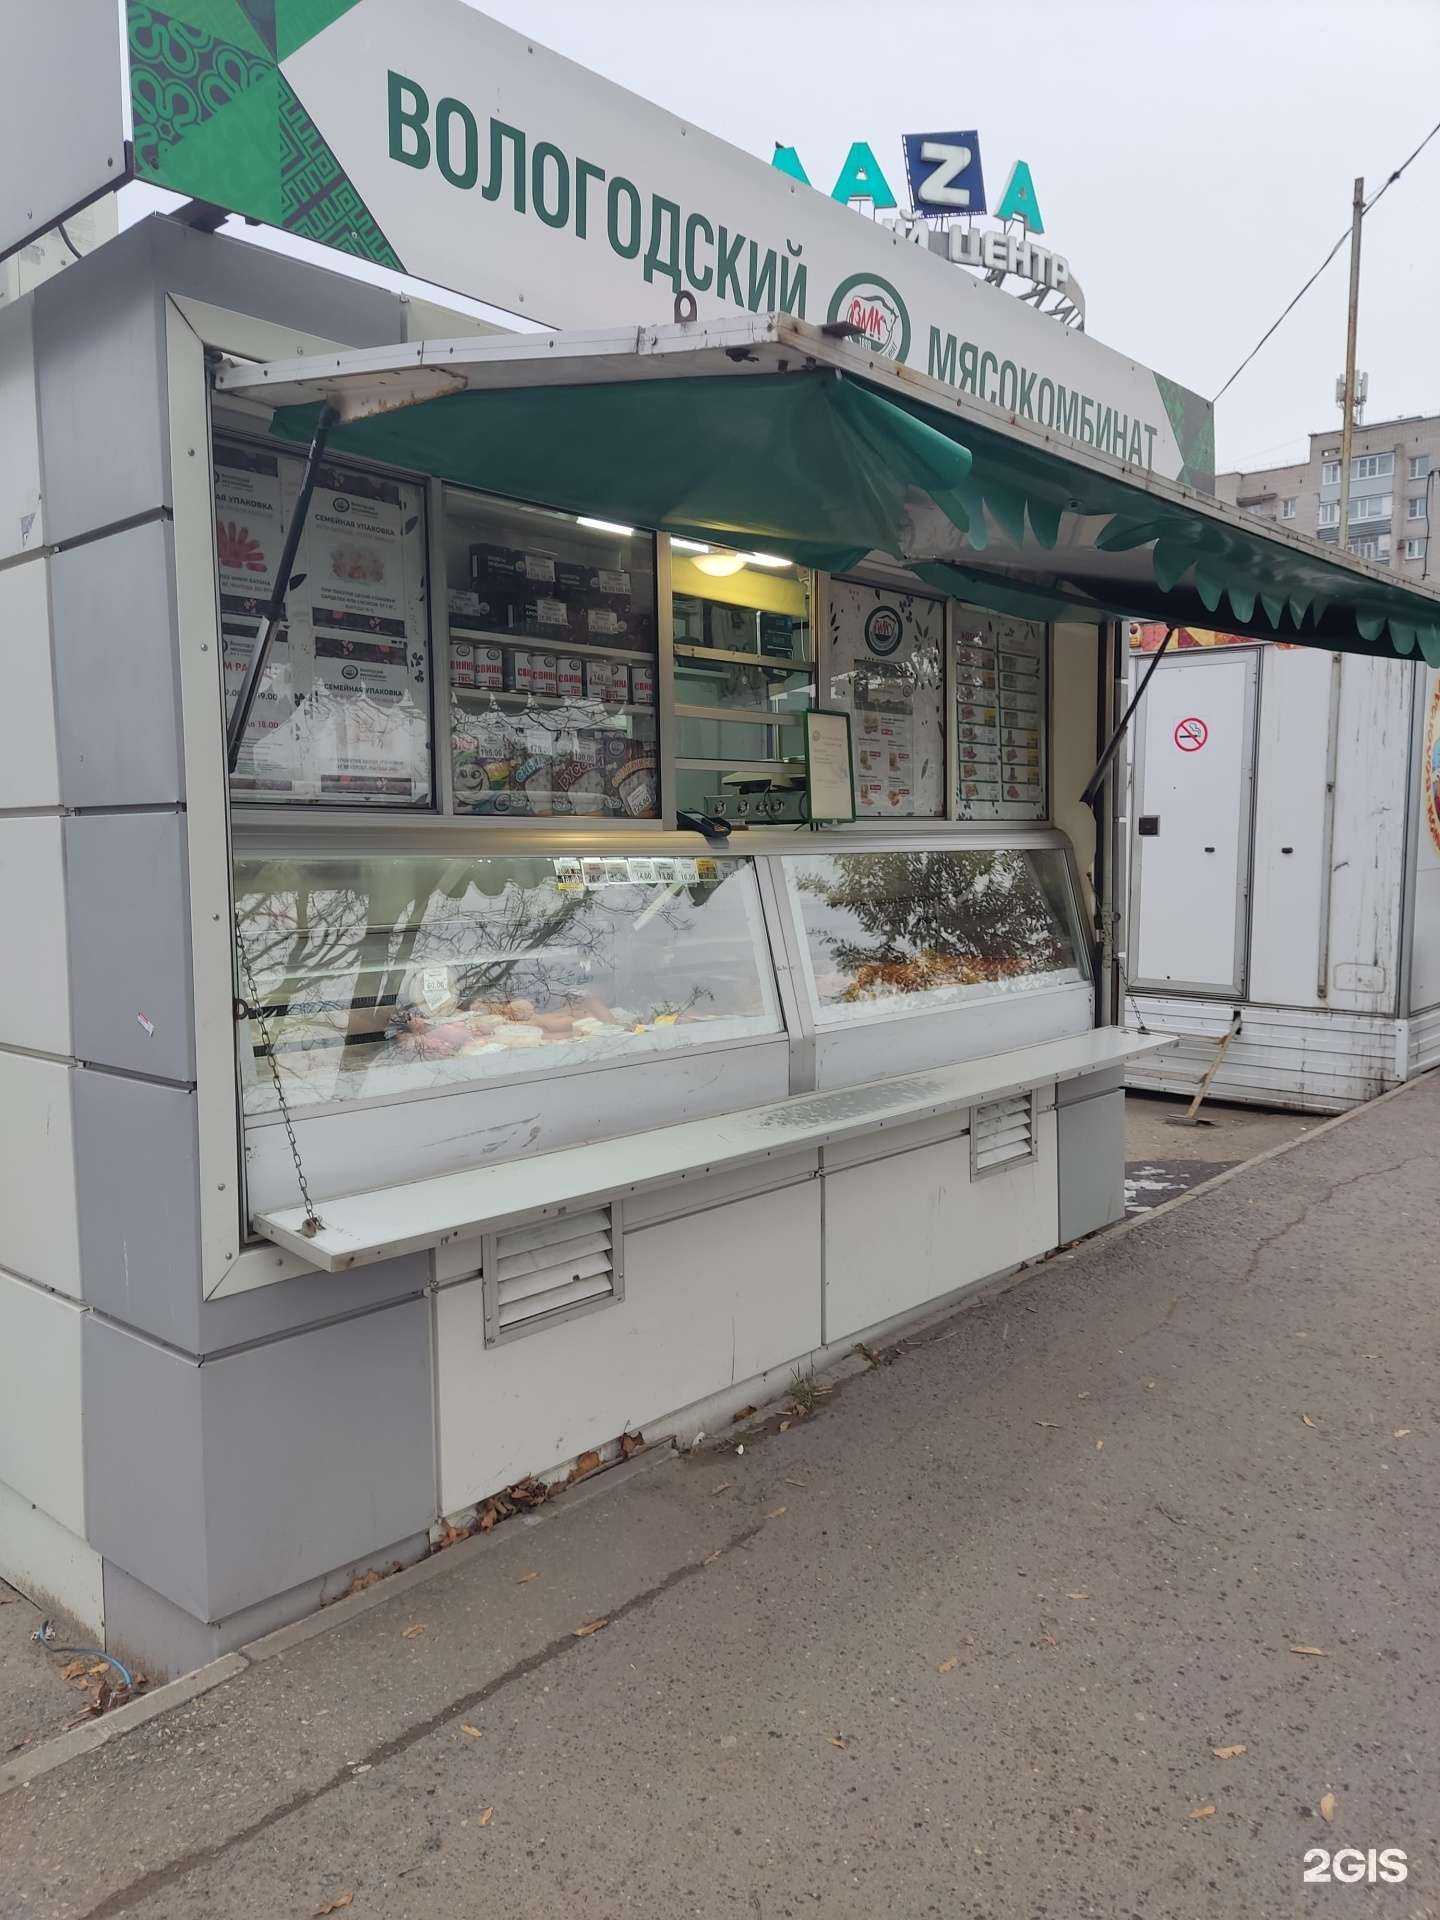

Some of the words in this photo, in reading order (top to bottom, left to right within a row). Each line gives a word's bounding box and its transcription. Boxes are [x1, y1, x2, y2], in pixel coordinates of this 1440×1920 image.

[387, 69, 808, 320] ВОЛОГОДСКИЙ
[948, 224, 1071, 289] ЦЕНТР
[927, 325, 1158, 471] МЯСОКОМБИНАТ
[314, 513, 355, 528] СЕМЕЙНАЯ
[355, 520, 396, 537] УПАКОВКА
[324, 683, 363, 694] СЕМЕЙНАЯ
[365, 687, 403, 697] УПАКОВКА
